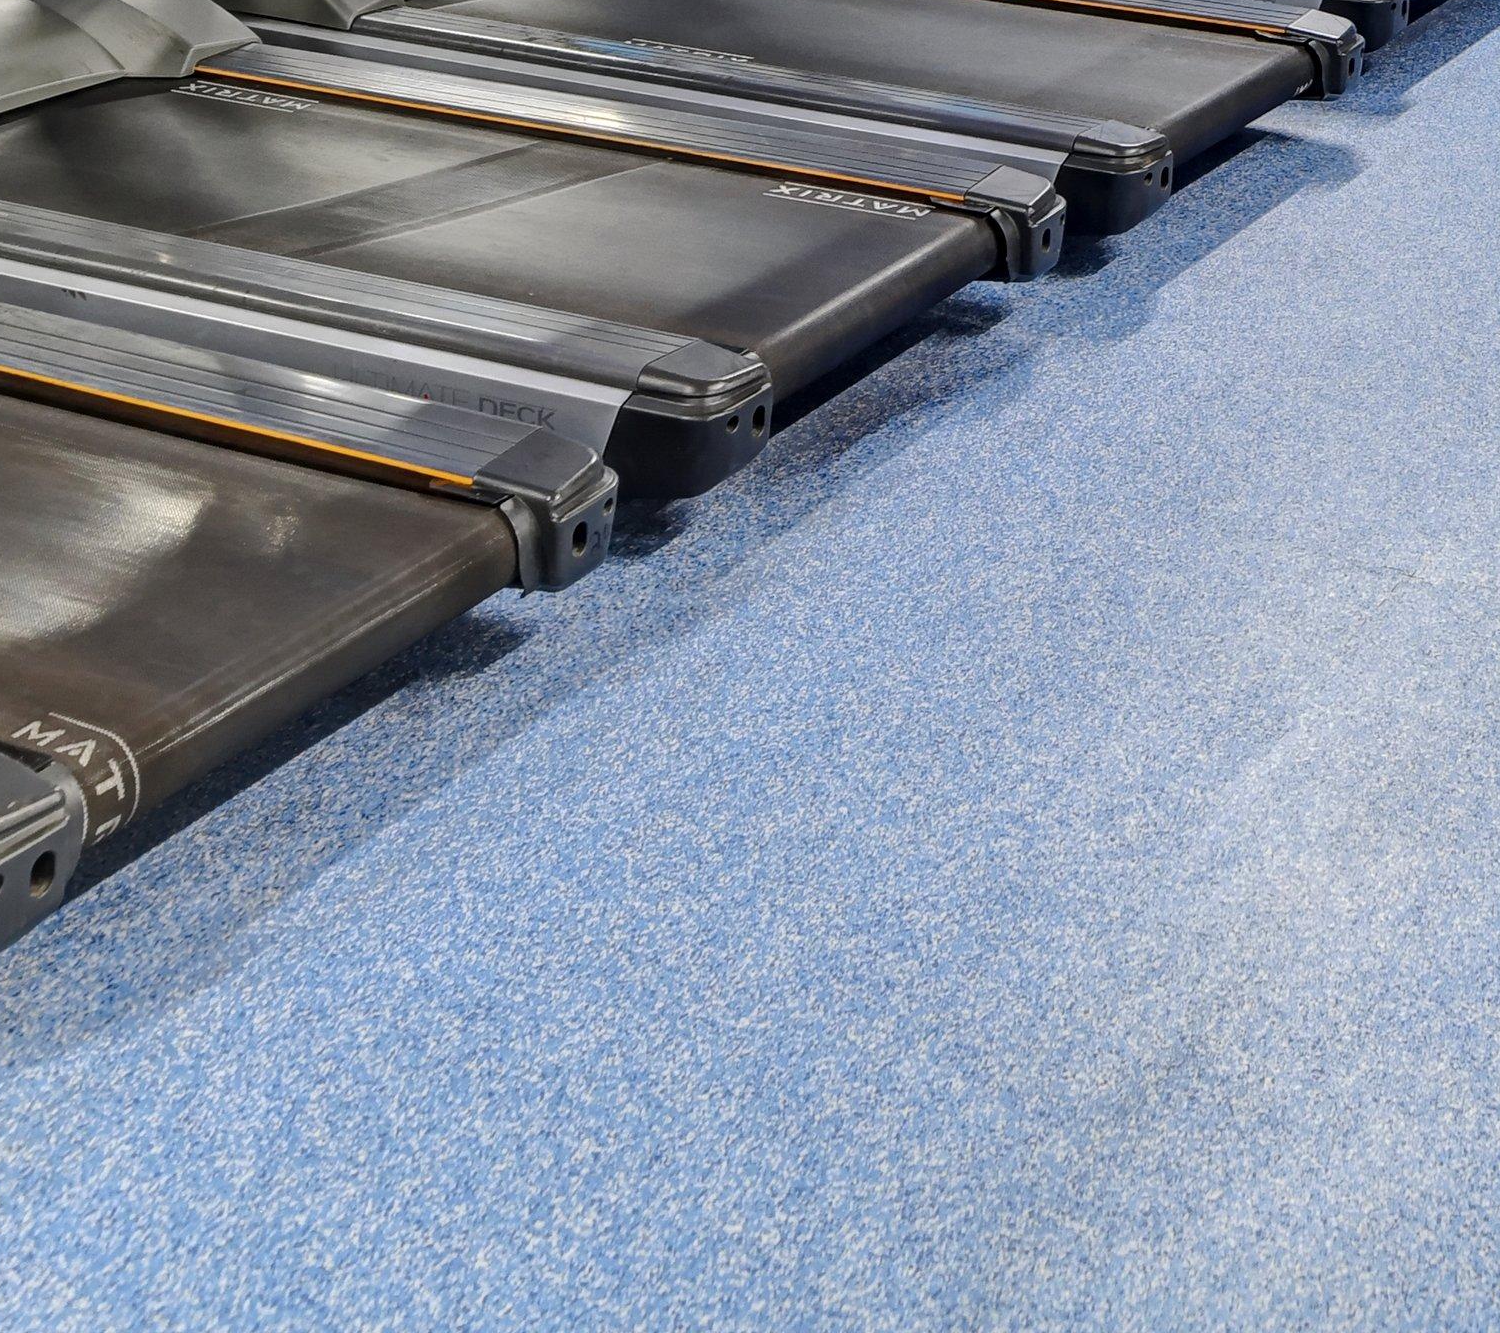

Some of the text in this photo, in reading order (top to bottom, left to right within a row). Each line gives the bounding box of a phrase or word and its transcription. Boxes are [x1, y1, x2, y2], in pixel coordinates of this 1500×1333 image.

[180, 81, 314, 110] MATRIX
[768, 183, 932, 218] MATRIX
[478, 396, 556, 431] DECK
